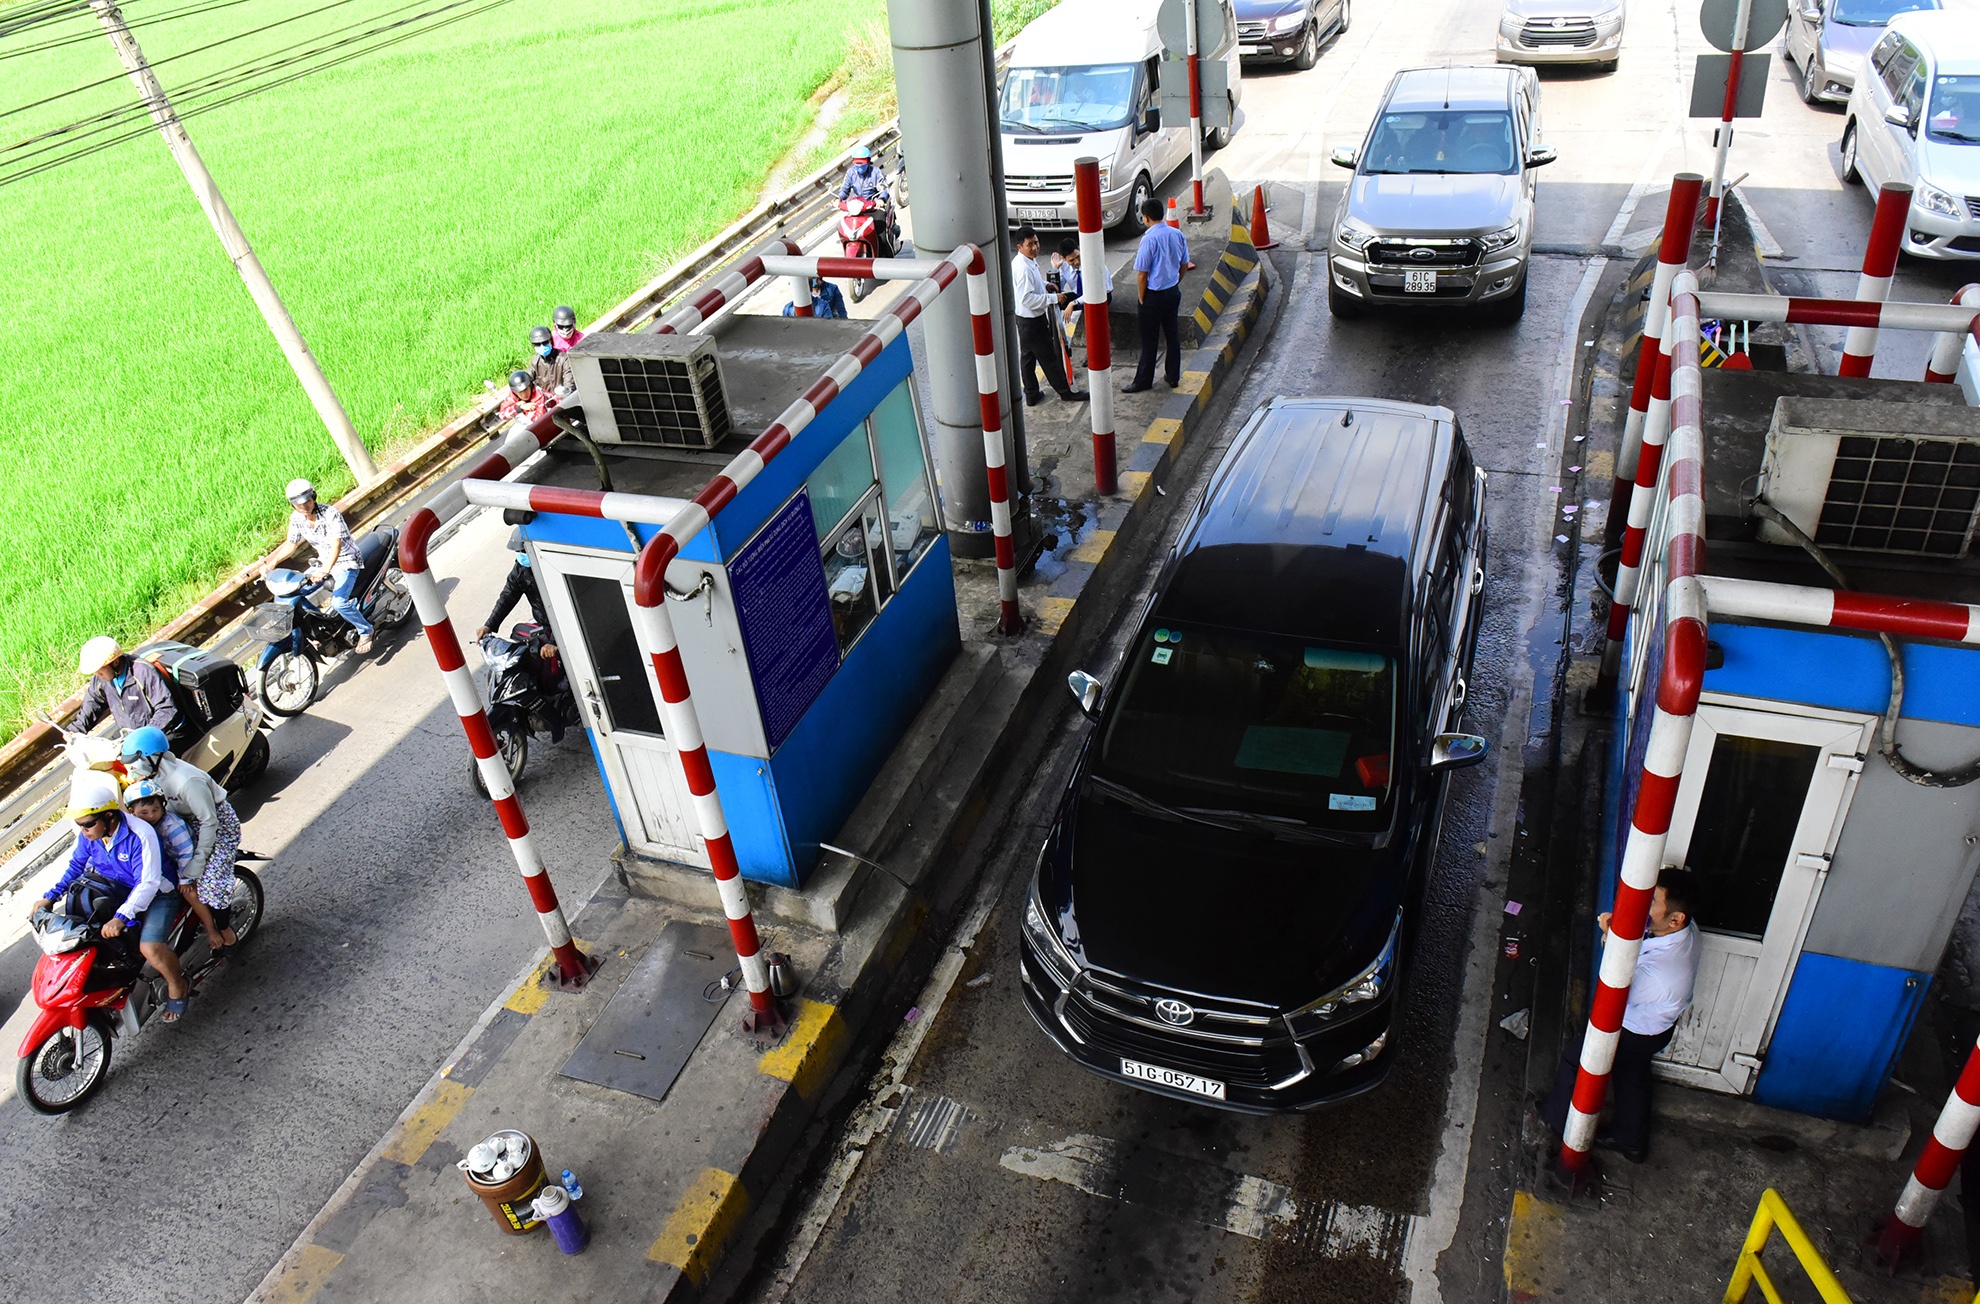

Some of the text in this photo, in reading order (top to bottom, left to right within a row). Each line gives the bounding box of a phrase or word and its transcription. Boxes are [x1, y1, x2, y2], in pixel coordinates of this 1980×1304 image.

[1412, 272, 1430, 282] 61C
[1405, 281, 1436, 292] 289.35
[1124, 1061, 1222, 1096] 51G-057.17
